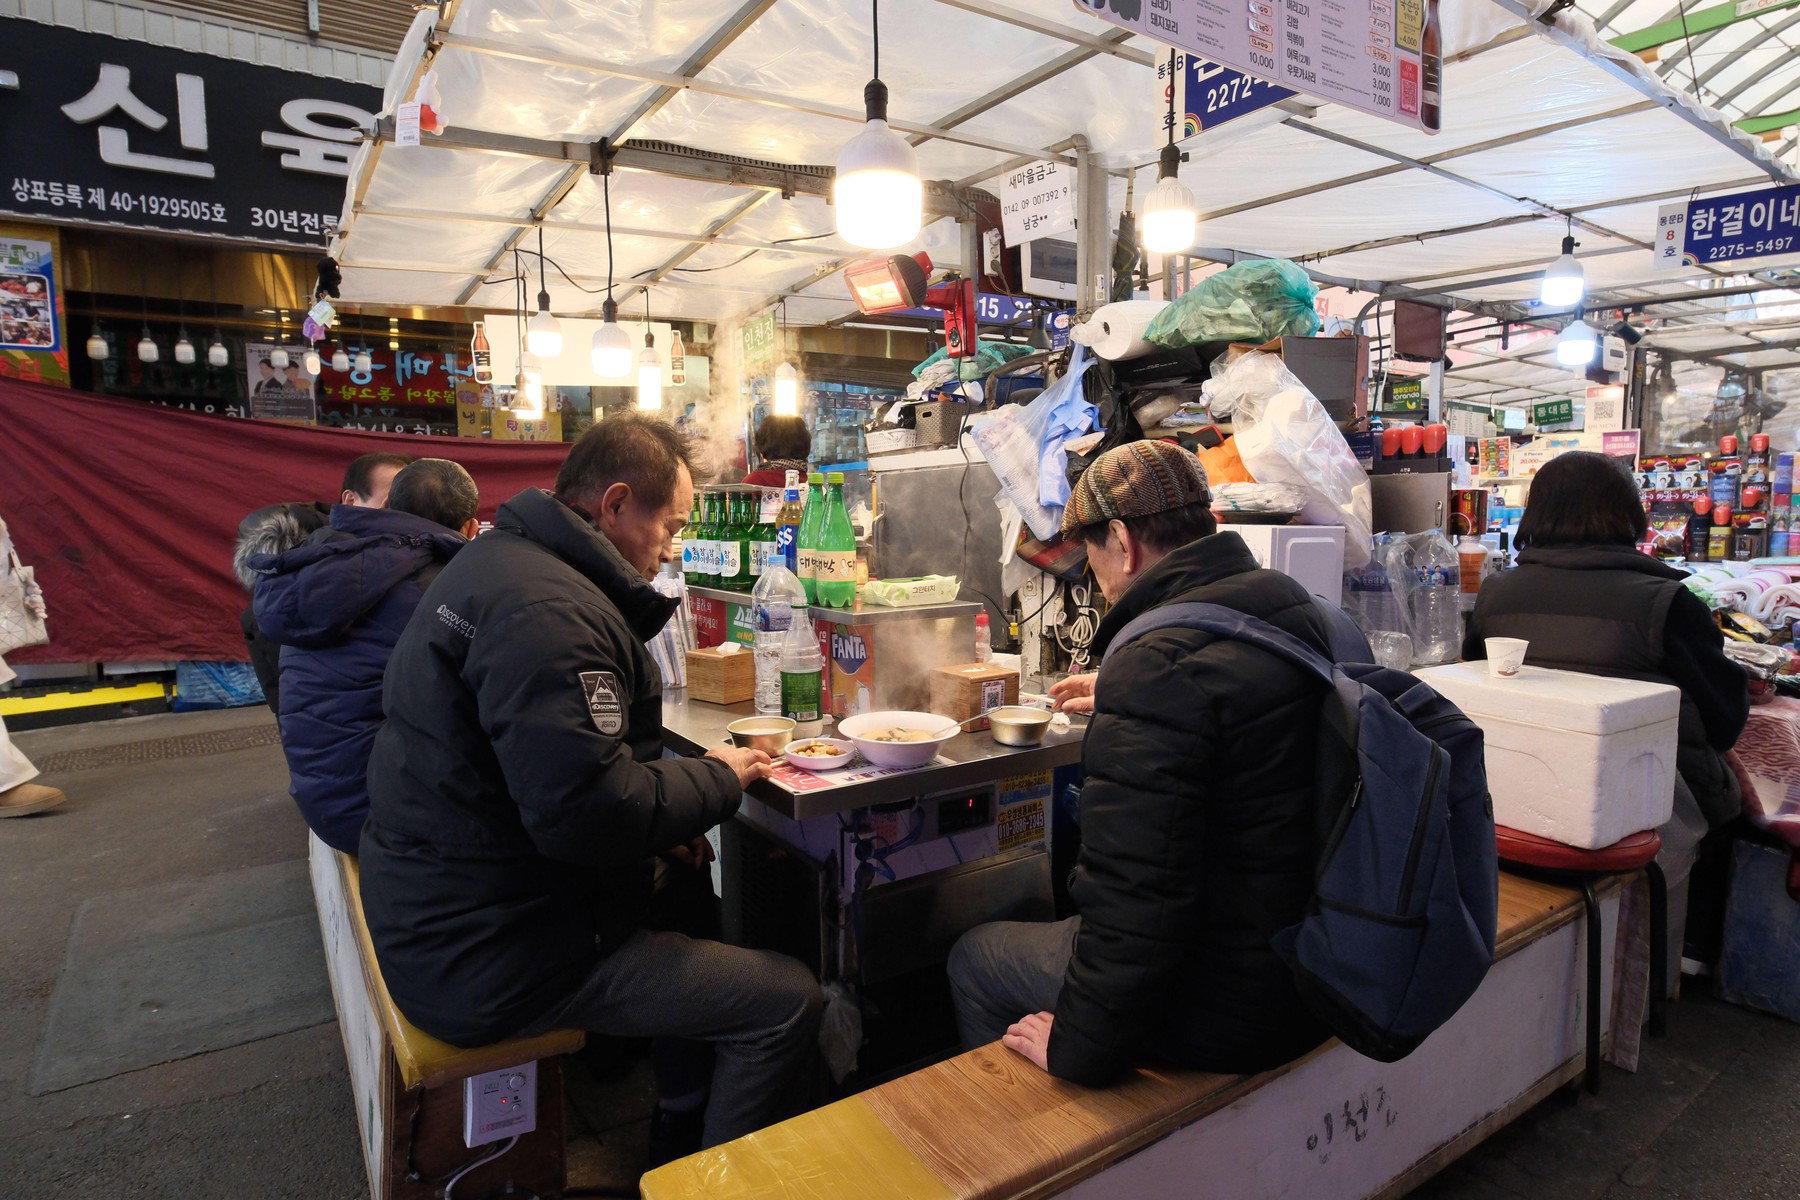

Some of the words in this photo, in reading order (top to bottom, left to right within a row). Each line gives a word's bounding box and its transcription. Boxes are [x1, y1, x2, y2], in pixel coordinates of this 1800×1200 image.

[1286, 15, 1299, 30] 김밥
[1286, 31, 1305, 48] 떡볶이
[1249, 51, 1275, 70] 10,000
[1372, 63, 1391, 78] 3,000
[1207, 74, 1276, 113] 2272-
[1372, 78, 1391, 93] 3,000
[1372, 93, 1391, 108] 7,000
[1008, 161, 1057, 190] 새마을금고
[11, 178, 83, 209] 상표등록
[87, 187, 107, 211] 제
[110, 191, 227, 224] 40-1929505호
[1003, 203, 1019, 216] 0142
[1021, 198, 1030, 210] 09
[1032, 190, 1060, 206] 007392
[1062, 186, 1068, 196] 9
[1660, 213, 1684, 226] 동문B
[1666, 230, 1675, 241] 8
[1663, 245, 1677, 258] 호
[1709, 237, 1794, 259] 2275-5497
[744, 317, 774, 351] 인천집
[506, 420, 548, 432] 탕후루
[831, 633, 867, 660] FANTA
